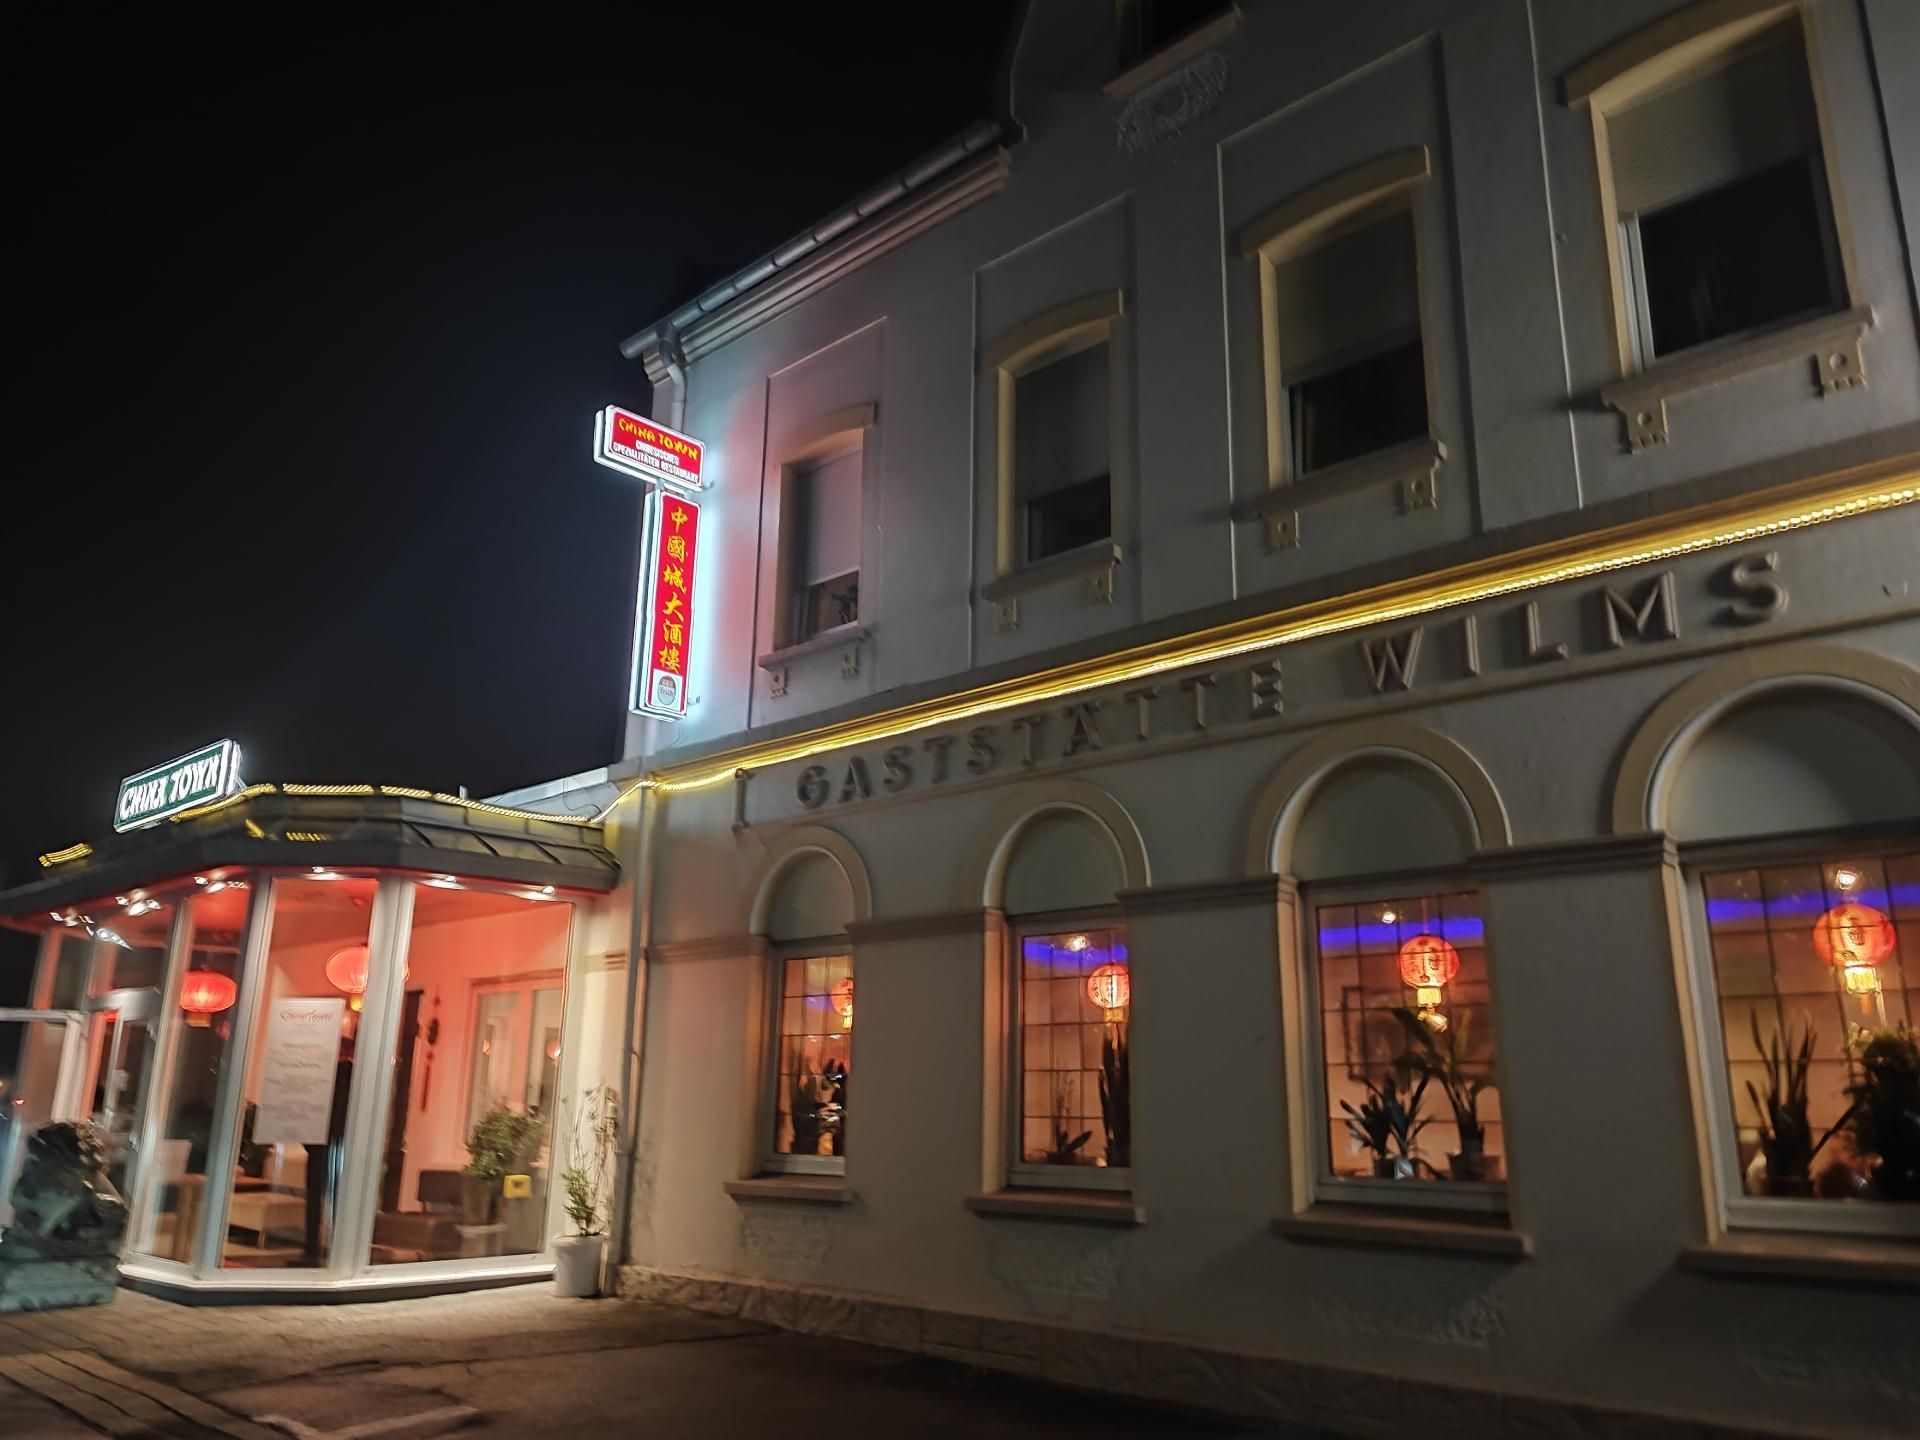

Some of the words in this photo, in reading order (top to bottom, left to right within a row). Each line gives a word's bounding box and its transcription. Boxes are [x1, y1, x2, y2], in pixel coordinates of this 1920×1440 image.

[618, 418, 656, 442] CHINA
[659, 433, 698, 460] TOWN
[658, 505, 689, 674] 中國城大酒樓
[1356, 550, 1790, 693] WILMS
[119, 775, 169, 820] CHINA
[169, 753, 222, 803] TOWN
